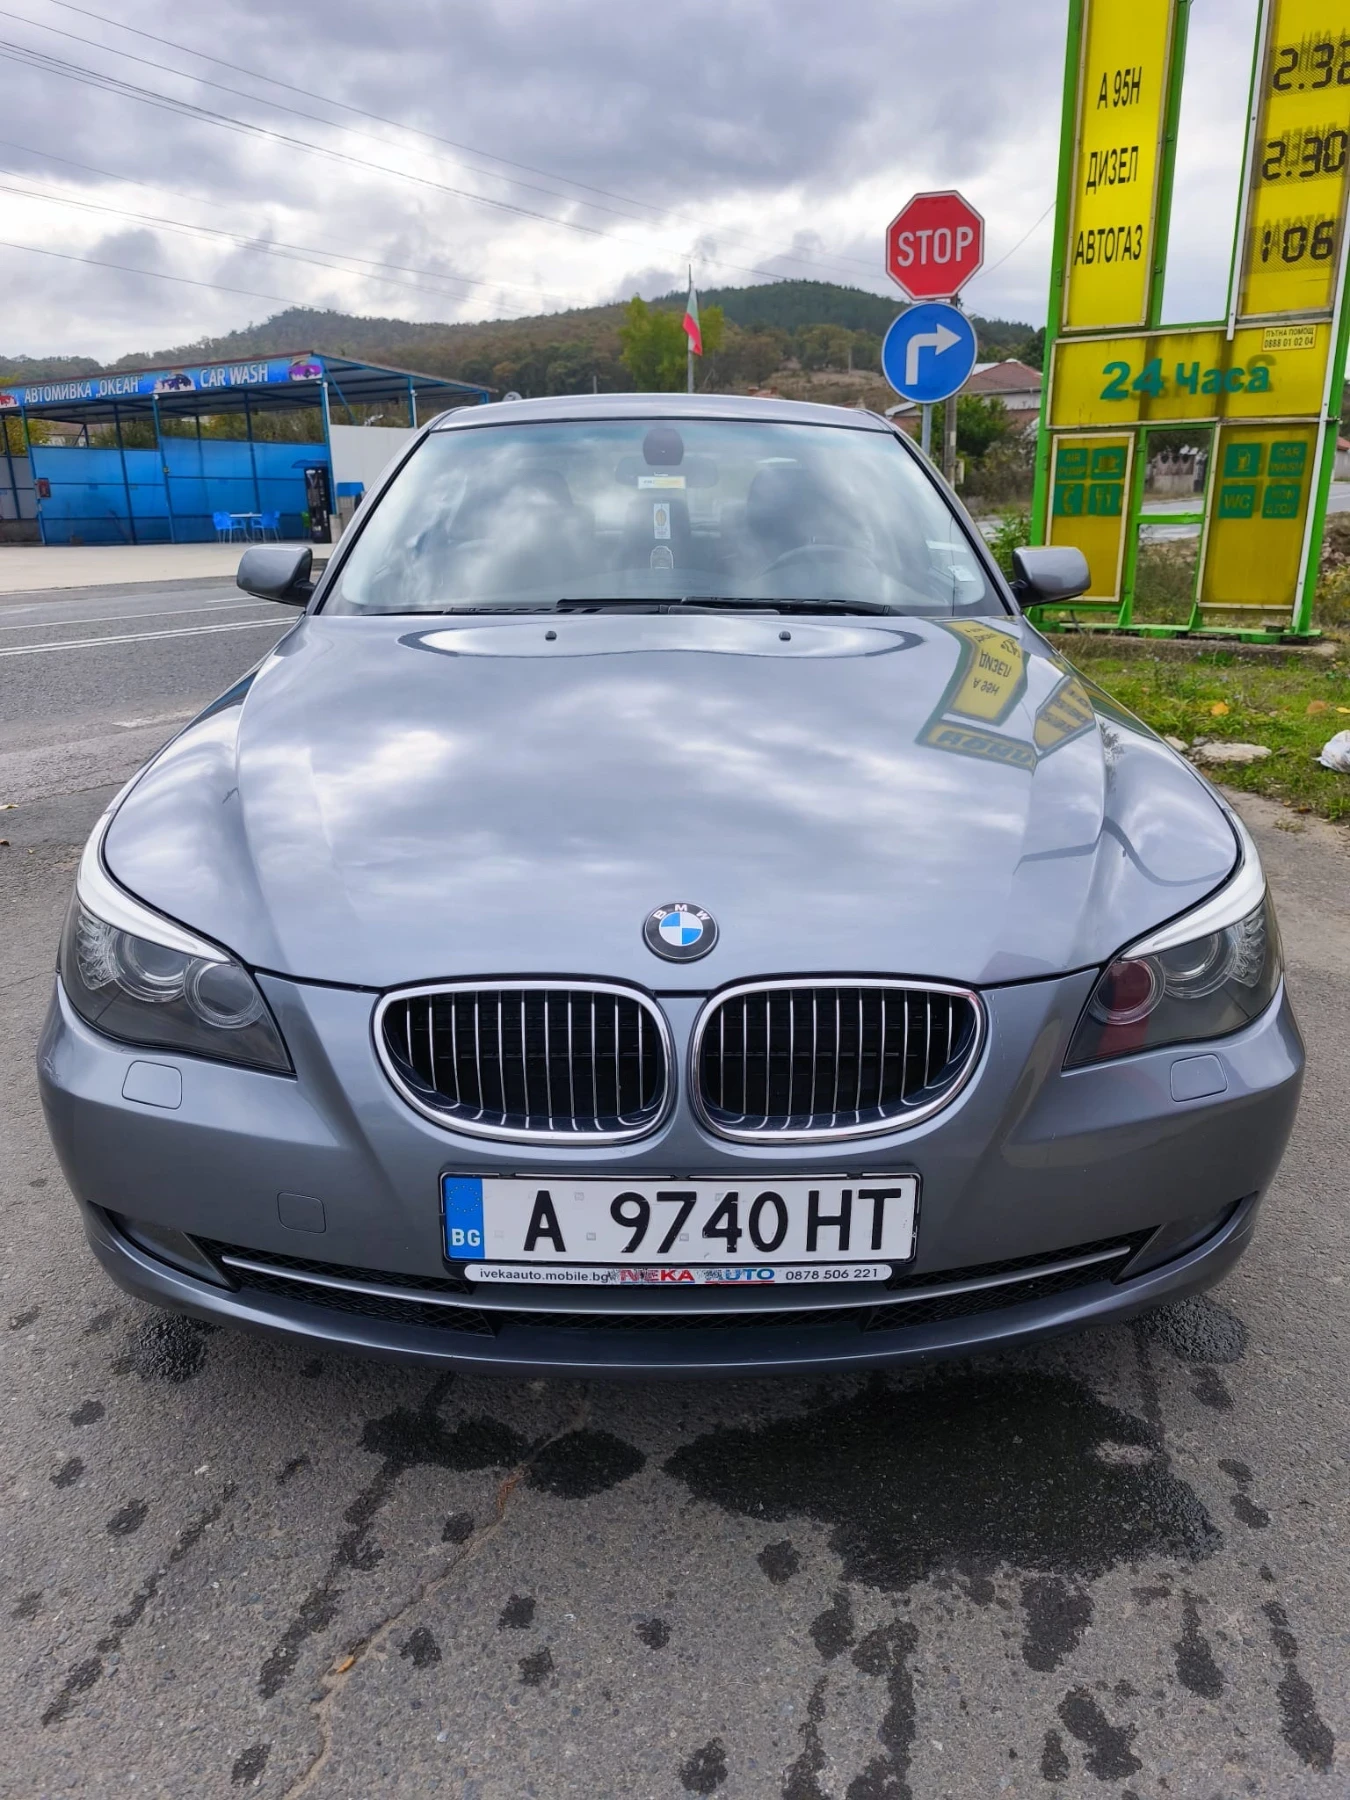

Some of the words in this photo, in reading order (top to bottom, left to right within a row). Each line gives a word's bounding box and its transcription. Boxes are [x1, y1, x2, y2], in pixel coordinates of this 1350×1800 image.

[1086, 146, 1139, 195] ДИЗЕЛ
[1262, 130, 1348, 181] 2.30
[897, 226, 974, 267] STOP
[1074, 224, 1143, 266] АВТОГАЗ
[200, 367, 226, 388] CAR
[229, 363, 268, 385] WASH
[1100, 358, 1164, 400] 24
[24, 382, 92, 403] АВТОМИВКА
[1224, 494, 1251, 509] WC
[653, 904, 710, 921] BMW
[523, 1190, 566, 1252] A
[610, 1189, 789, 1253] 9740
[806, 1188, 902, 1252] HT
[451, 1228, 481, 1247] BG
[480, 1268, 609, 1283] ivekaauto.mobile.bg
[785, 1270, 820, 1280] 0878
[823, 1269, 849, 1280] 506
[853, 1269, 878, 1278] 221
